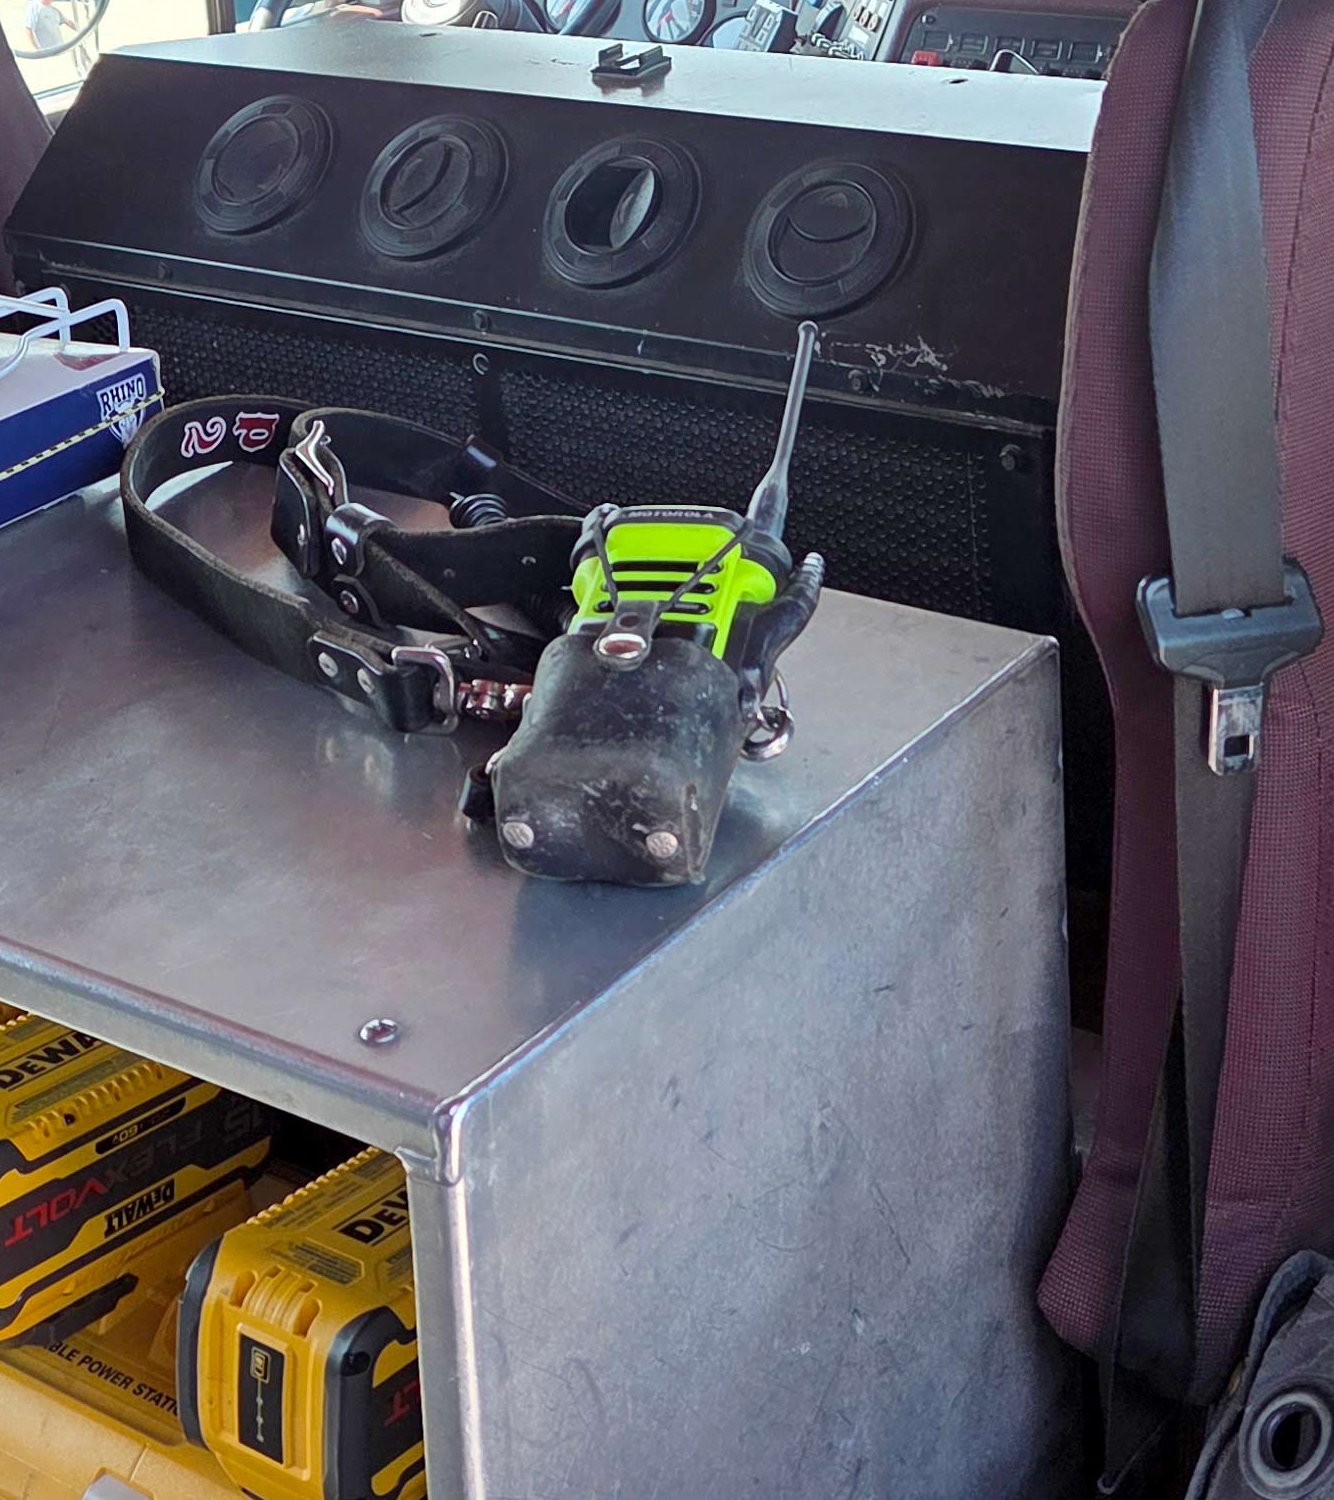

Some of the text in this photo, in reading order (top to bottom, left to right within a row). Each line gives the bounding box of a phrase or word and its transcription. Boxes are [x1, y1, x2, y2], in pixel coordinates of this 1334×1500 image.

[100, 376, 145, 415] RHINO
[104, 1182, 172, 1236] DEWALT
[77, 1354, 134, 1390] POWER
